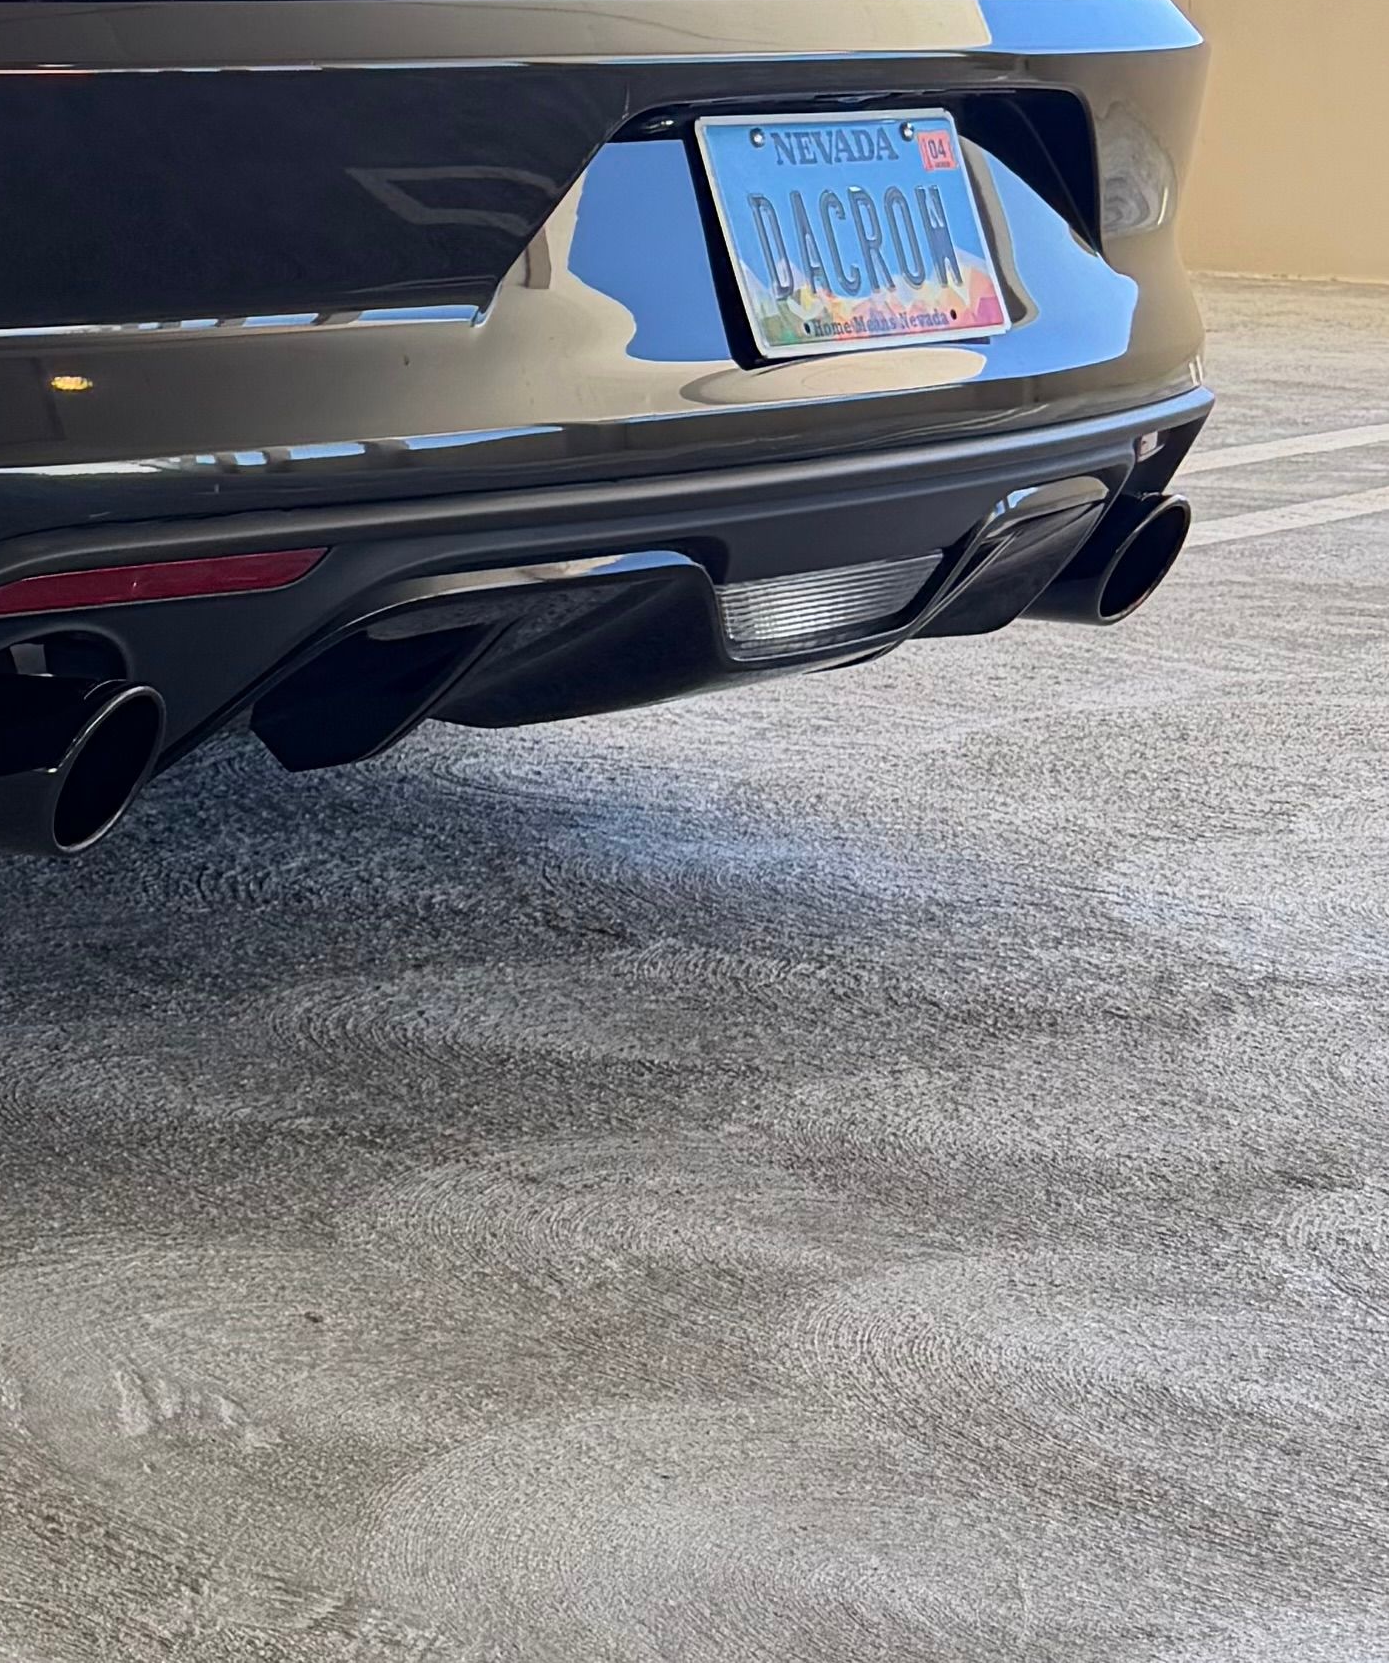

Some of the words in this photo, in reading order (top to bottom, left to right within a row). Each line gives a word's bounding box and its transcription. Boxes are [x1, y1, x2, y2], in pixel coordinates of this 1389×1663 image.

[770, 127, 900, 166] NEVADA
[928, 138, 947, 159] 04
[813, 318, 852, 337] Home
[899, 309, 949, 330] Nevada
